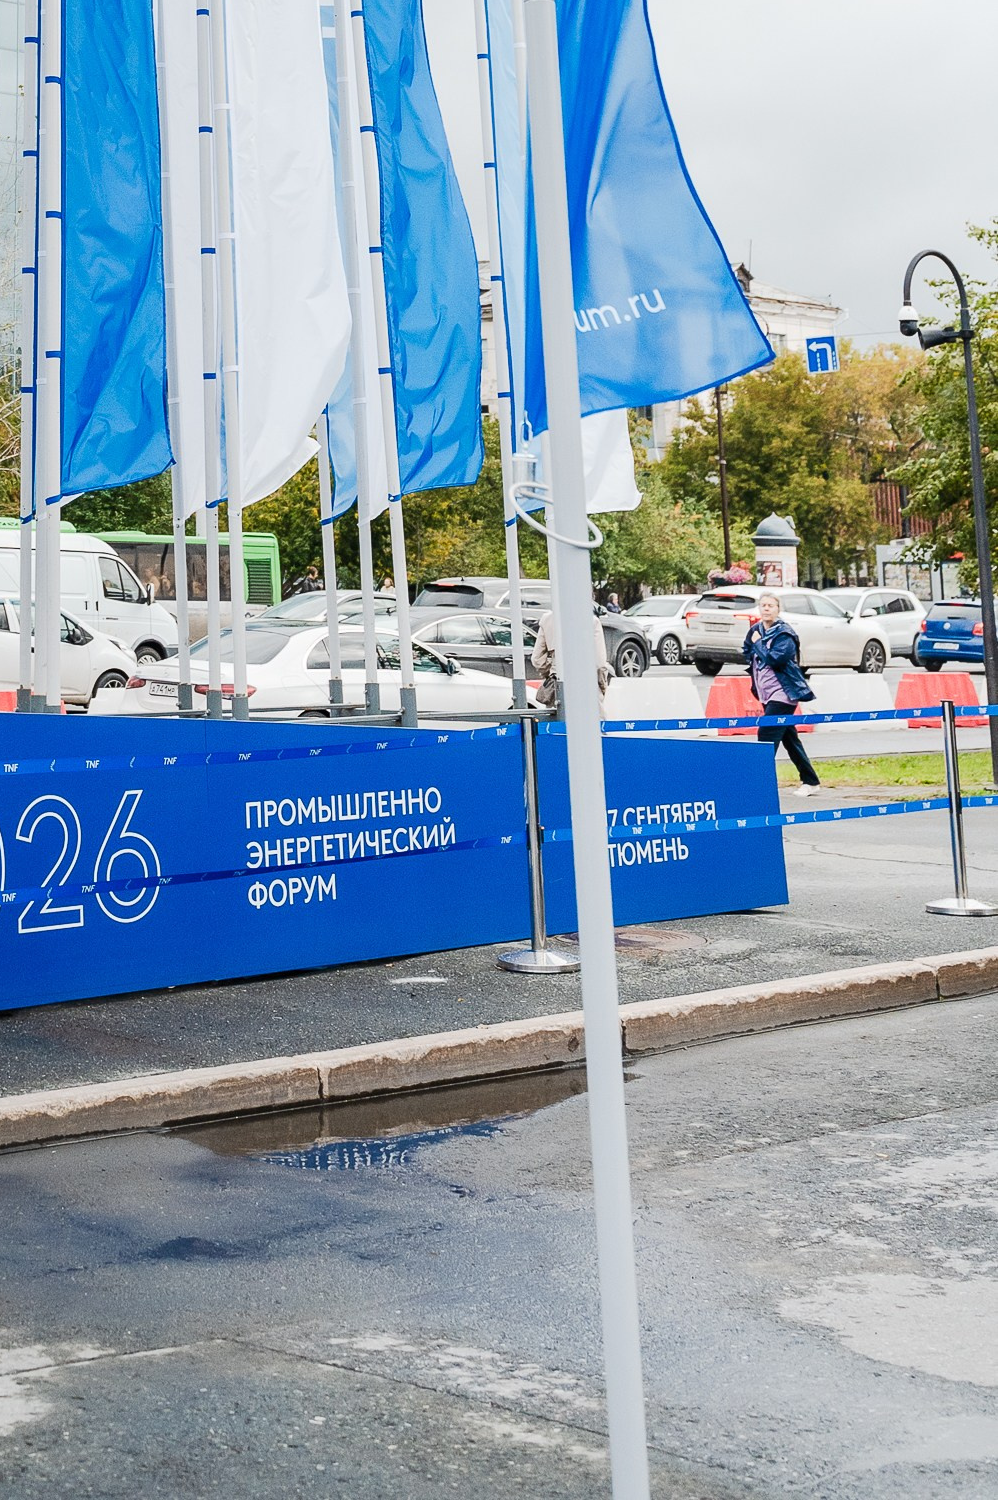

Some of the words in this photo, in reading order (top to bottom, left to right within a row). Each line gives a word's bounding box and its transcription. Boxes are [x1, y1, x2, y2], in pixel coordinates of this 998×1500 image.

[3, 763, 19, 773] TNF
[85, 759, 100, 769] TNF
[163, 756, 178, 766] TNF
[238, 752, 252, 761] TNF
[309, 748, 323, 756] TNF
[376, 742, 389, 750] TNF
[437, 734, 450, 744] TNF
[495, 727, 507, 736] TNF
[245, 786, 442, 830] ПРОМЫШЛЕННО
[622, 800, 717, 827] СЕНТЯБРЯ
[245, 816, 457, 870] ЭНЕРГЕТИЧЕСКИЙ
[607, 836, 690, 868] ТЮМЕНЬ
[1, 892, 17, 903] TNF
[81, 884, 96, 894] TNF
[158, 877, 173, 885] TNF
[247, 873, 338, 910] ФОРУМ
